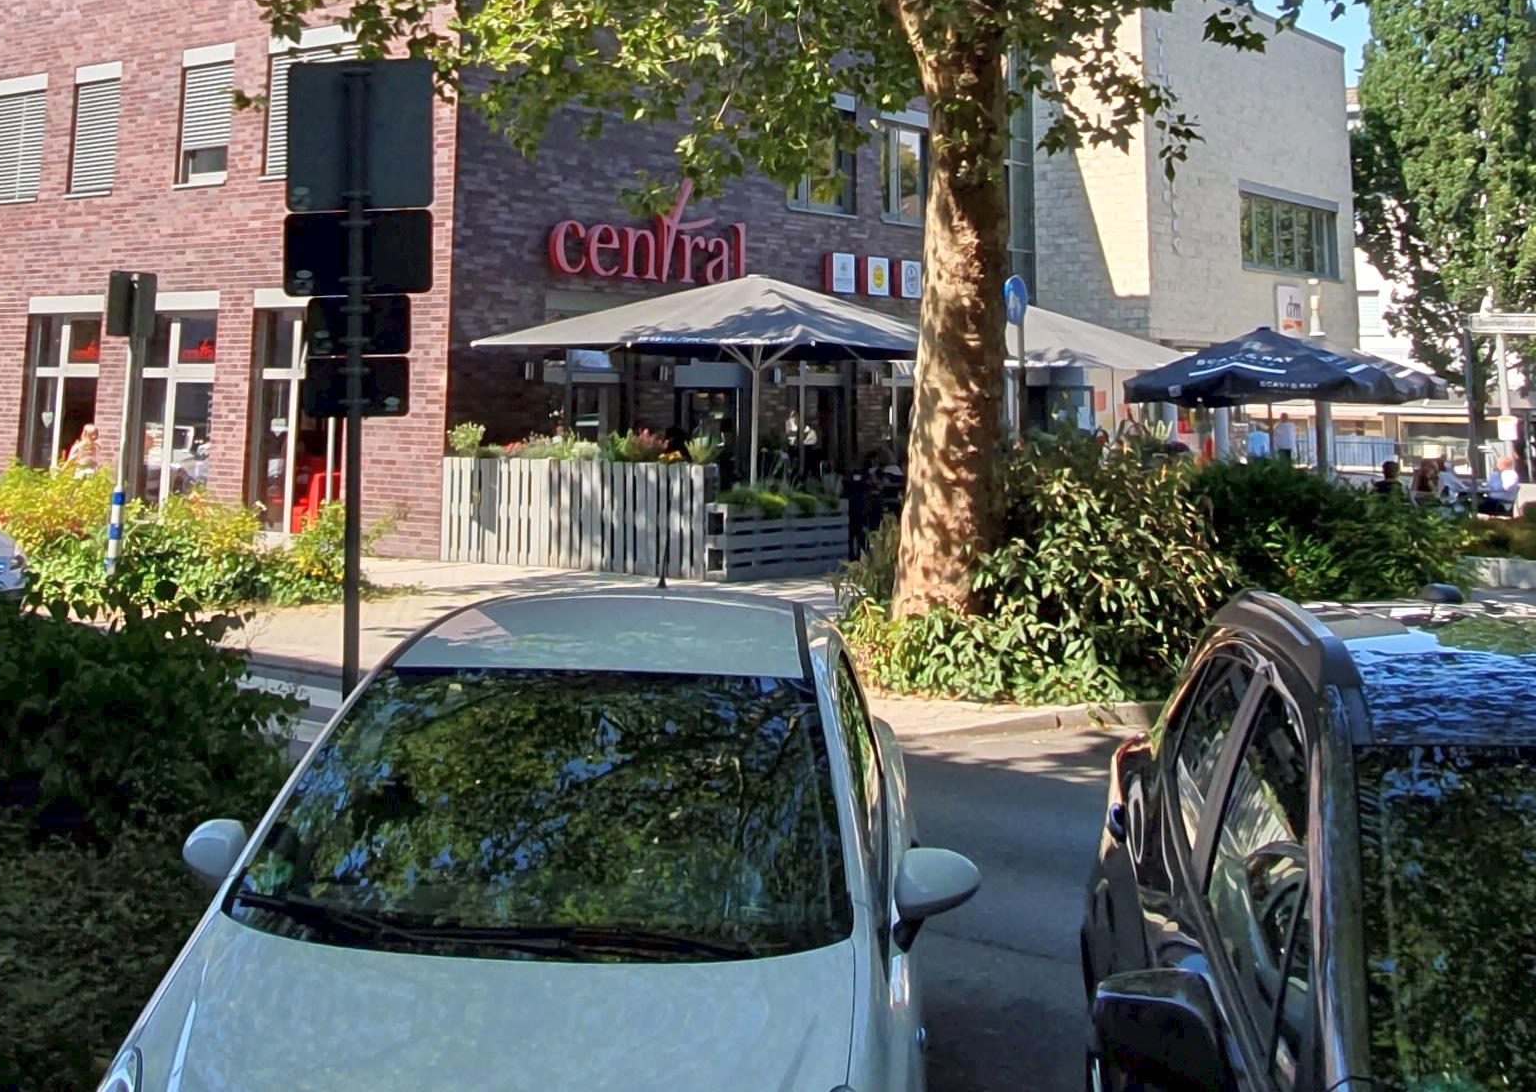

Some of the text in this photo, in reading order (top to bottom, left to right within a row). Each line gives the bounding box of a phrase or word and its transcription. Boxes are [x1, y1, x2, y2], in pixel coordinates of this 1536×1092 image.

[549, 178, 747, 284] central
[1286, 295, 1302, 319] dm
[1259, 380, 1288, 388] SCAVI
